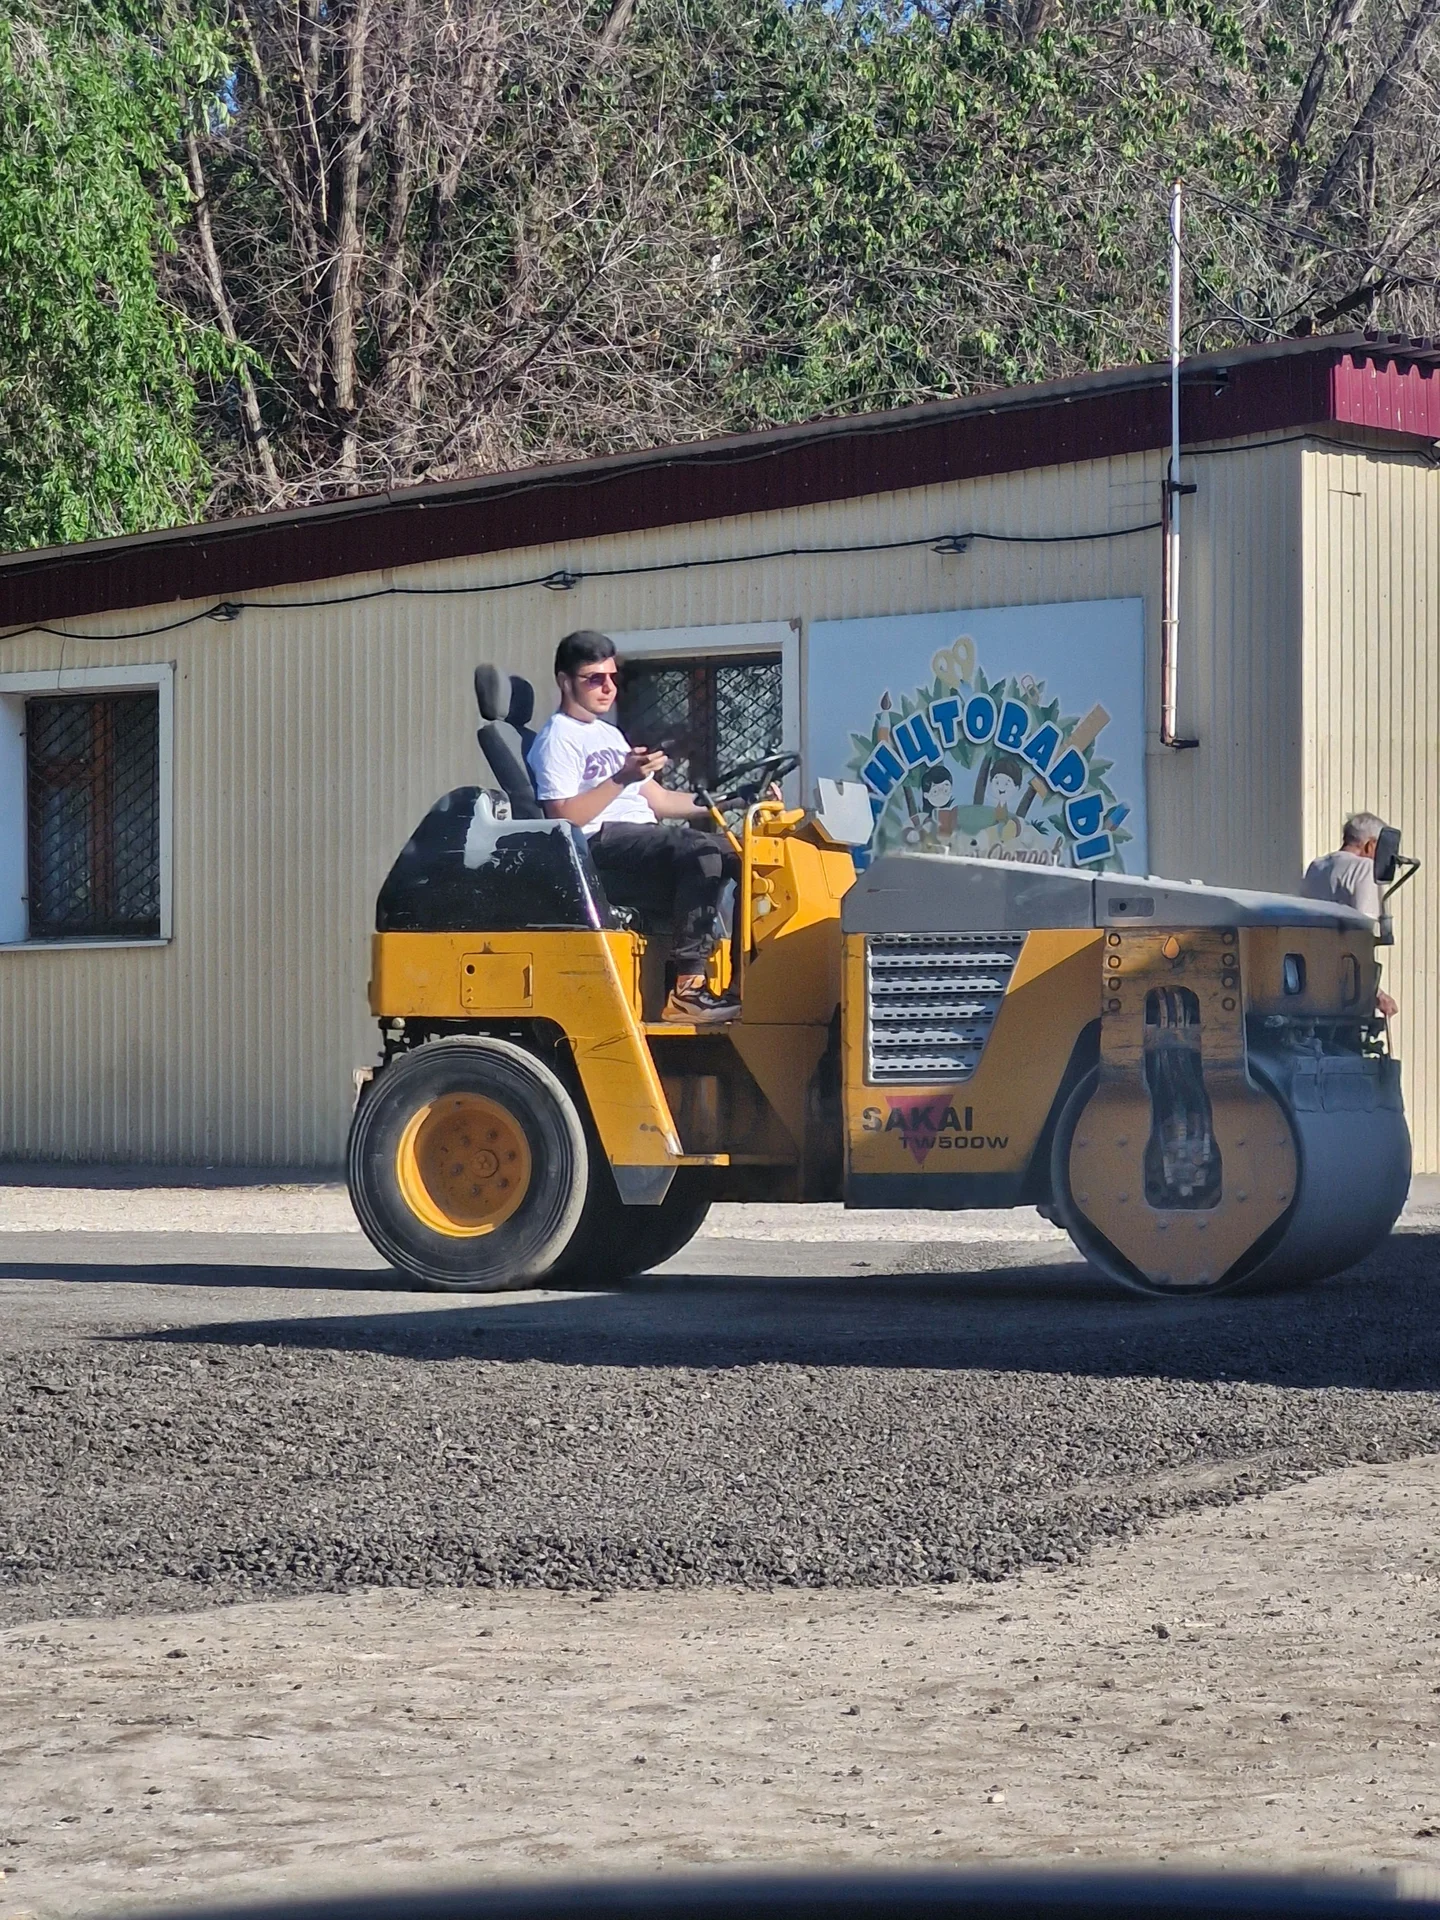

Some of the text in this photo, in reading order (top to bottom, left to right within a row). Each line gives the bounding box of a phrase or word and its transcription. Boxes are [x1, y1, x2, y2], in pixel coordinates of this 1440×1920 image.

[851, 696, 1111, 870] НЦТОВАРЫ
[862, 1106, 973, 1132] SAKAI
[898, 1136, 1009, 1149] TW500W
